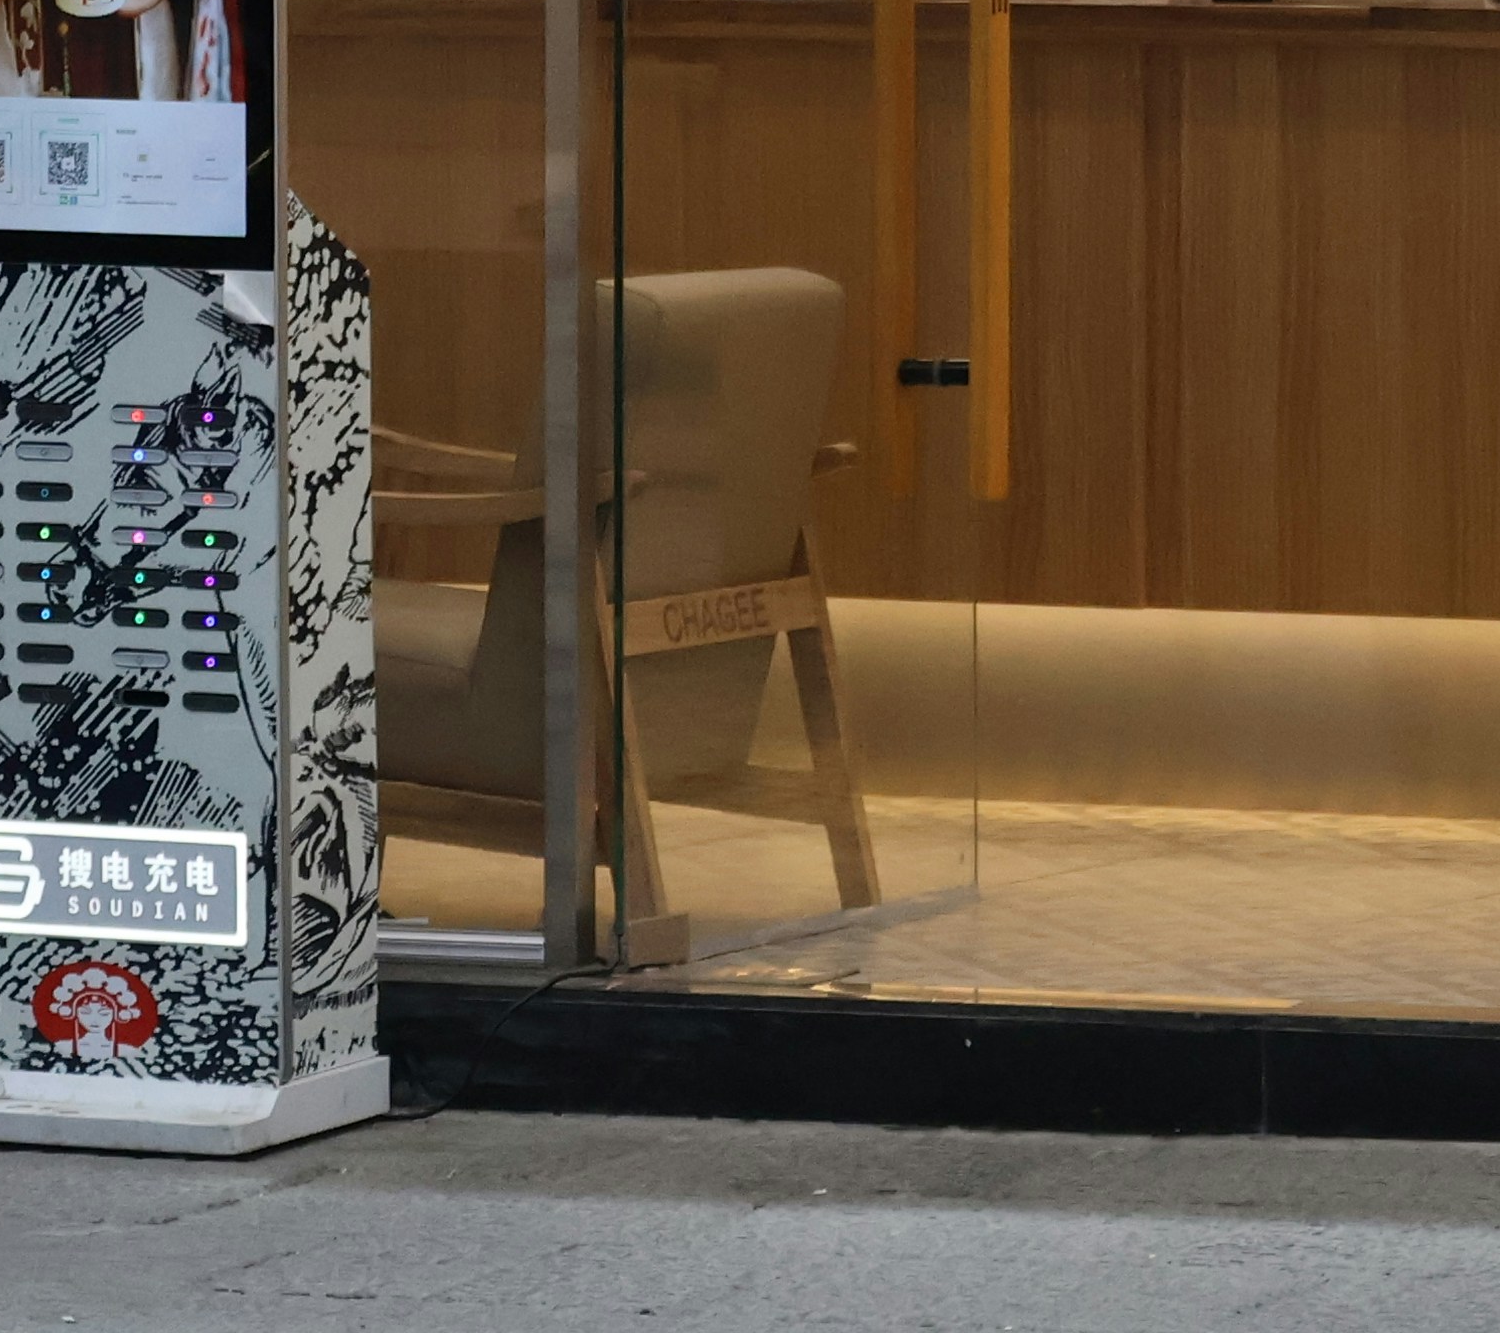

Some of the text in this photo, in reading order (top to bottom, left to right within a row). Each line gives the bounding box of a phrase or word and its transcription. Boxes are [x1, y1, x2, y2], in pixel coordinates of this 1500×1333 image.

[663, 587, 768, 643] CHAGEE
[58, 846, 219, 896] 搜电充电
[68, 895, 209, 923] SOUDIAN
